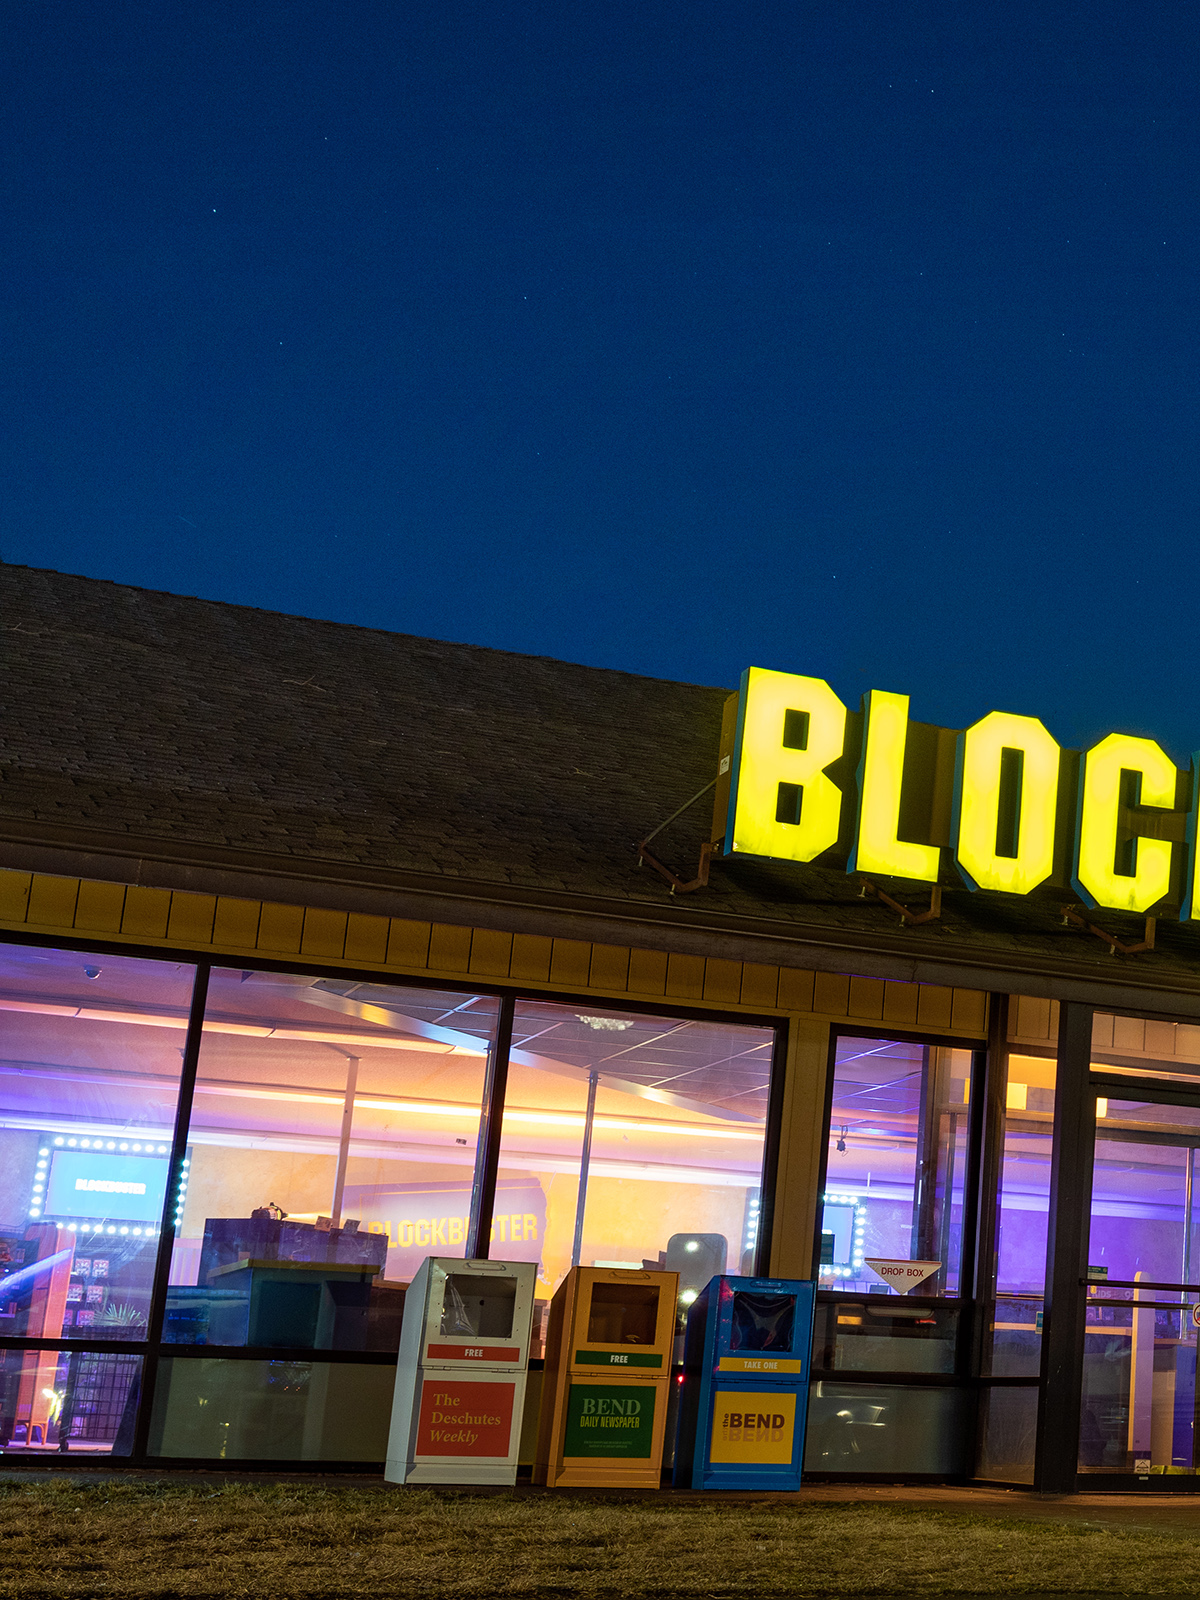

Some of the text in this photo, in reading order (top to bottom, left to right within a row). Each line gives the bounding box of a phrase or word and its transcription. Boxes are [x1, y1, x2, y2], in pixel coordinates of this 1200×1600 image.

[881, 1267, 924, 1277] DROP BOX
[464, 1348, 484, 1357] FREE
[610, 1354, 629, 1363] FREE
[744, 1361, 778, 1370] TAKE ONE
[433, 1393, 460, 1406] The
[581, 1398, 641, 1416] BEND
[431, 1411, 501, 1426] Deschutes
[580, 1416, 640, 1428] DAILY NEWSPAPER
[722, 1413, 786, 1429] the BEND
[429, 1429, 478, 1447] Weekly
